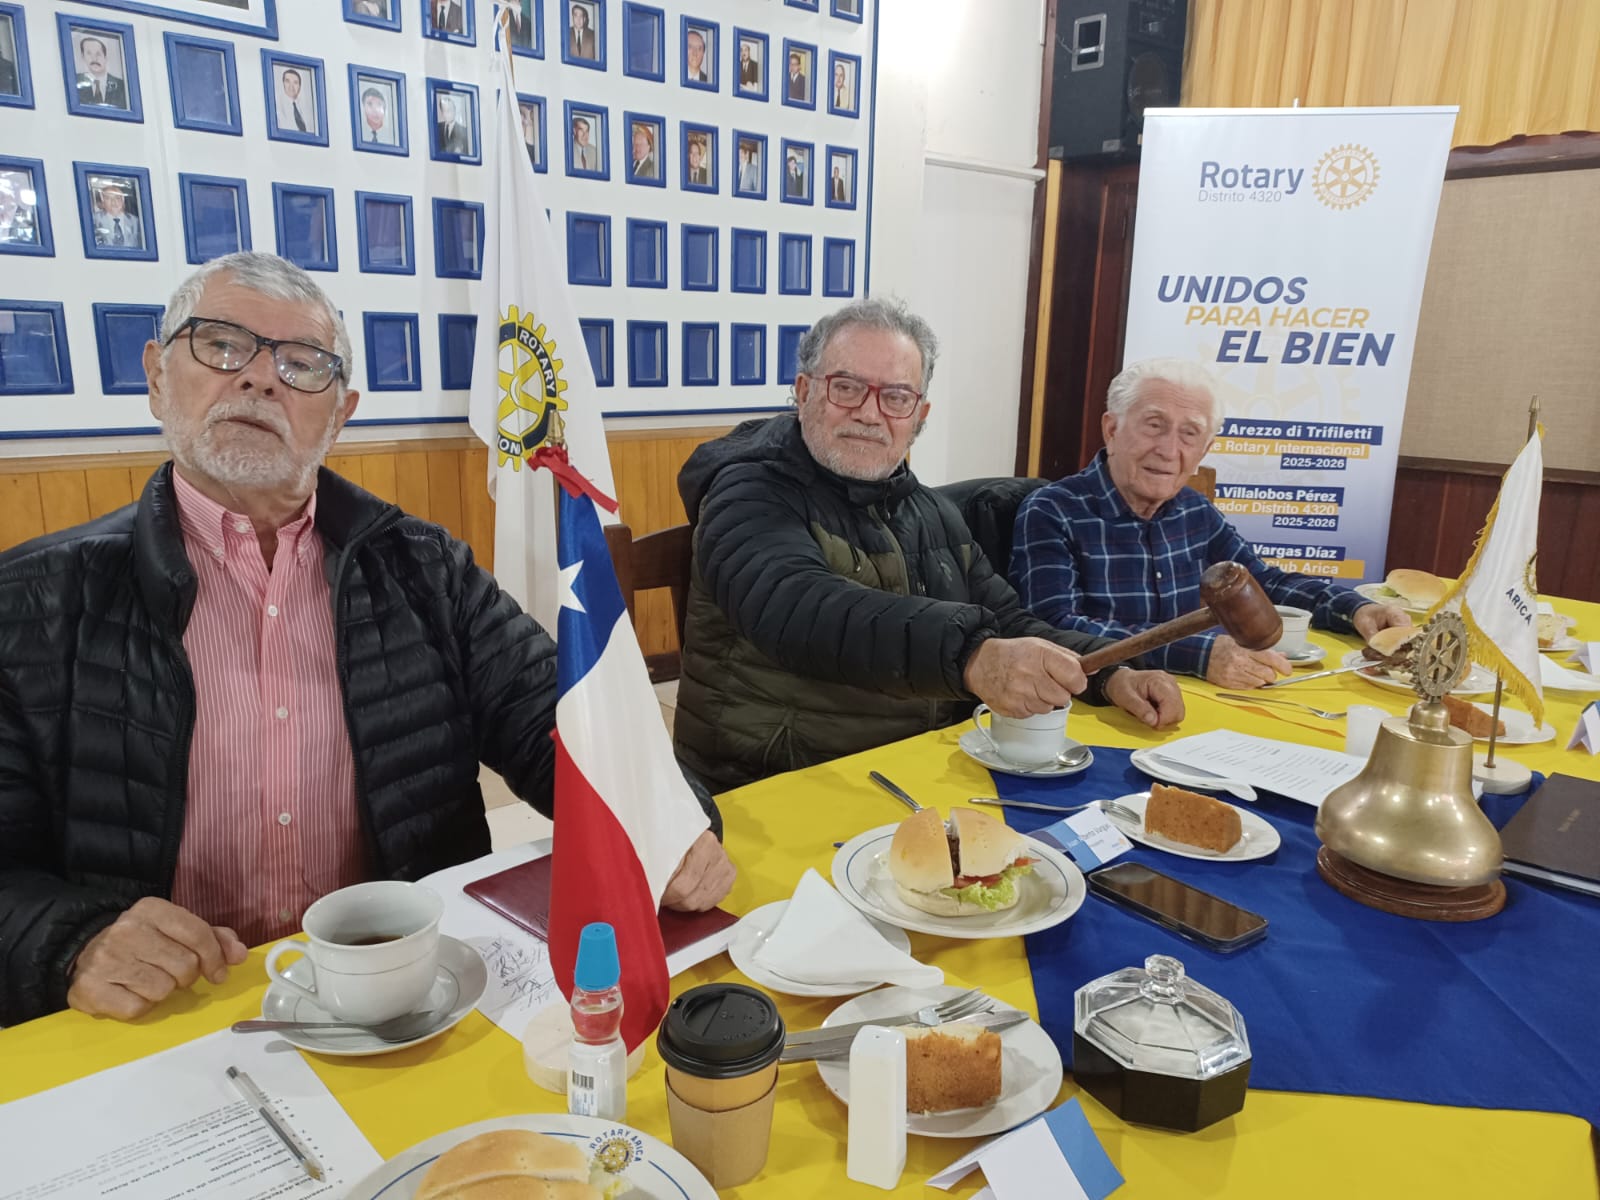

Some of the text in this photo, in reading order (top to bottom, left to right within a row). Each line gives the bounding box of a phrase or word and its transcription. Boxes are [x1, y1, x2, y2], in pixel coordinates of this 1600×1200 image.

[1200, 161, 1304, 195] Rotary
[1198, 190, 1282, 202] Distrito 4320
[1157, 275, 1308, 305] UNIDOS
[1185, 305, 1370, 329] PARA HACER
[1216, 330, 1395, 367] EL BIEN
[519, 329, 556, 393] ROTARY
[1228, 423, 1282, 437] Arezzo
[1286, 425, 1302, 438] di
[1306, 426, 1373, 440] Trifiletti
[1225, 441, 1270, 456] Rotary
[1275, 442, 1365, 457] Internacional
[1282, 457, 1345, 469] 2025-2026
[1223, 486, 1293, 500] Villalobos
[1296, 488, 1337, 502] Pérez
[1251, 502, 1299, 514] Distrito
[1303, 505, 1335, 515] 4320
[1275, 516, 1336, 528] 2025-2026
[1252, 543, 1337, 559] Vargas Díaz
[1302, 562, 1339, 575] Arica
[1505, 587, 1532, 626] ARICA
[590, 1128, 644, 1162] ROTARY ARICA
